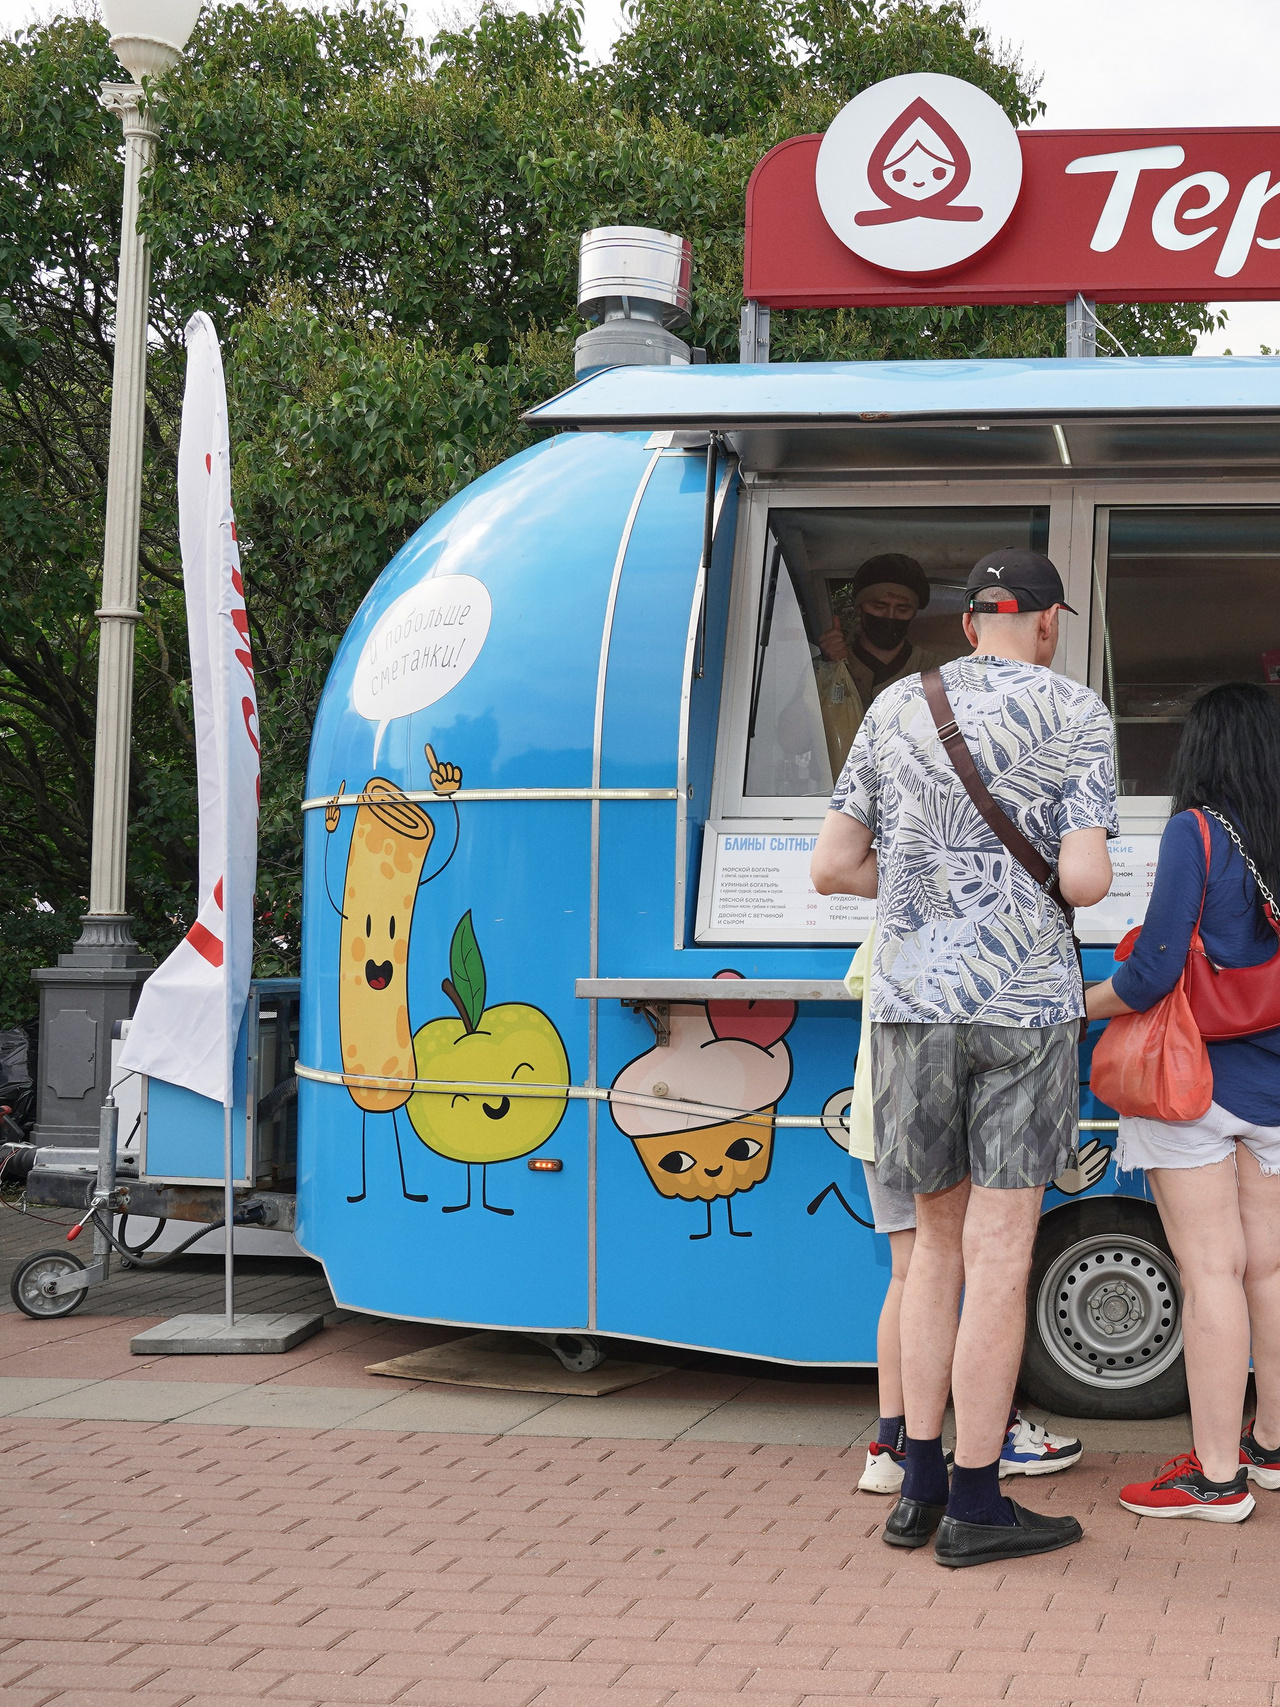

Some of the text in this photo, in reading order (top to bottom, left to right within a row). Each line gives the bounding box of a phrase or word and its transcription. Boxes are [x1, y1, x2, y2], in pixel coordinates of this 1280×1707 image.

[385, 605, 471, 651] побольше
[371, 638, 466, 696] сметанки!
[724, 837, 766, 851] БЛИНЫ
